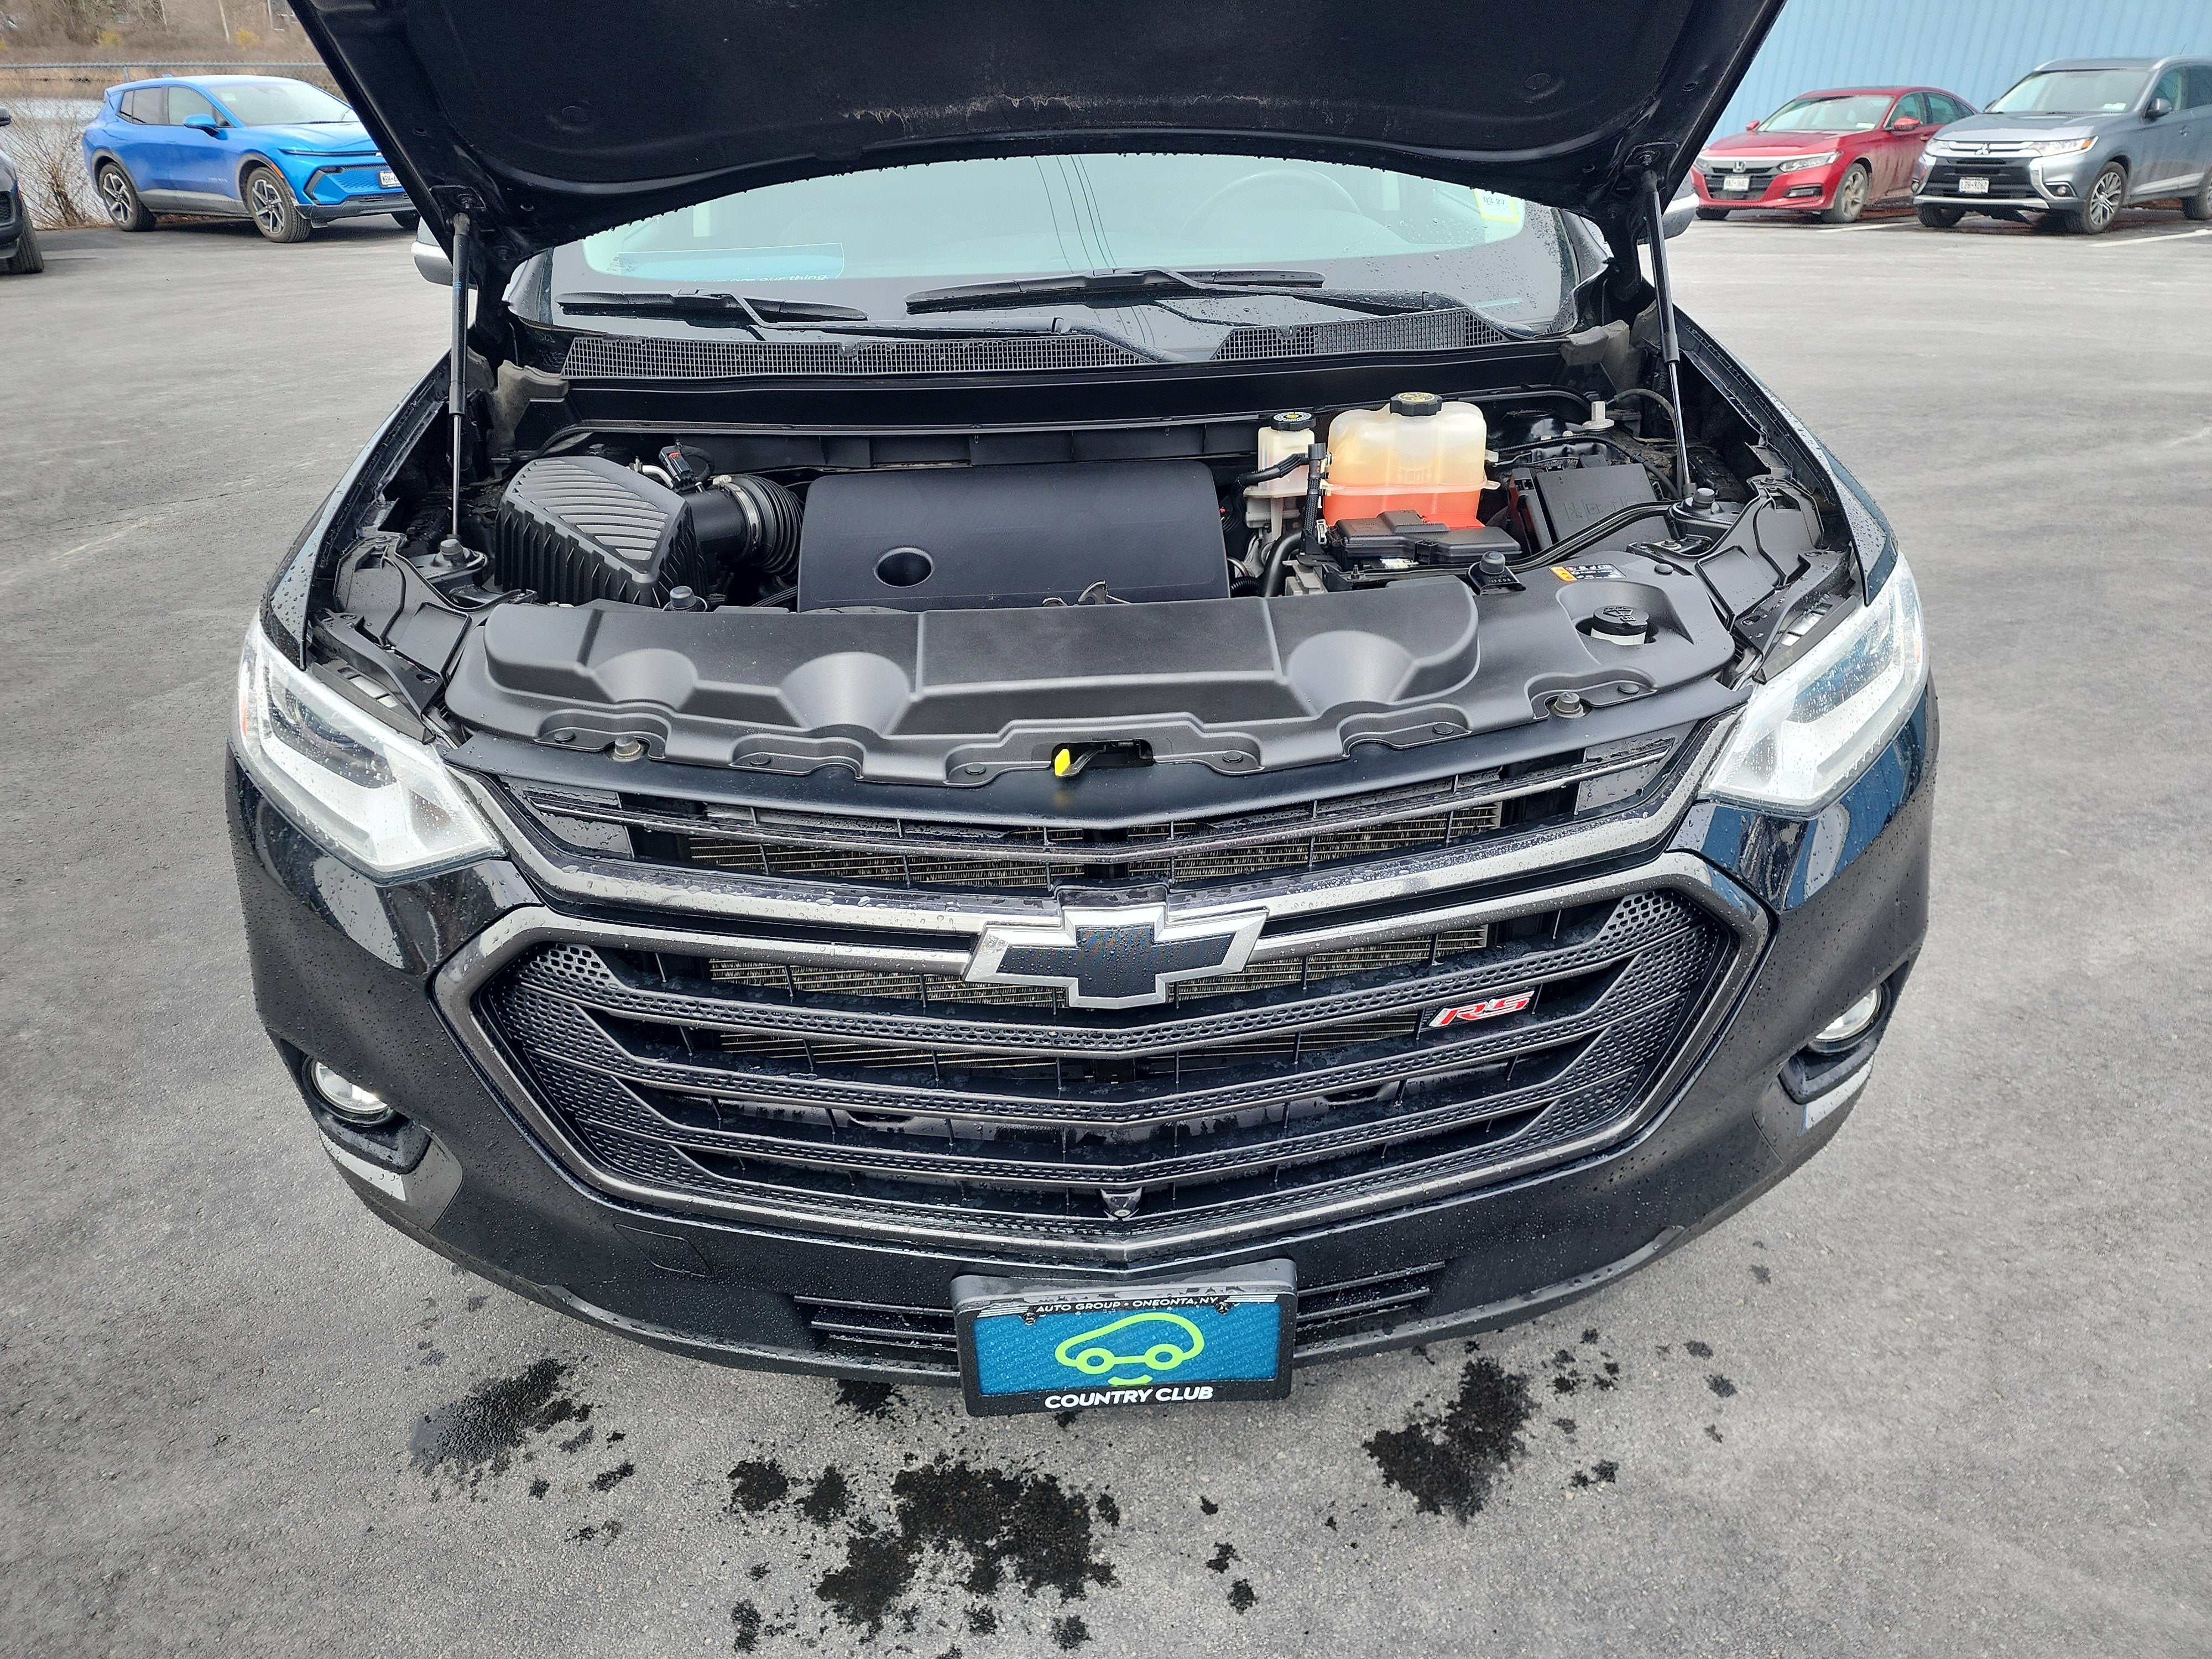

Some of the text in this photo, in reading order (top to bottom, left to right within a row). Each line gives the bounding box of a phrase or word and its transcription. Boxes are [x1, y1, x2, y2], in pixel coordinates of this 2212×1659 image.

[1429, 991, 1535, 1027] RS
[1036, 1304, 1072, 1313] AUTO
[1075, 1301, 1121, 1311] GROUP
[1045, 1386, 1214, 1409] COUNTRY CLUB
